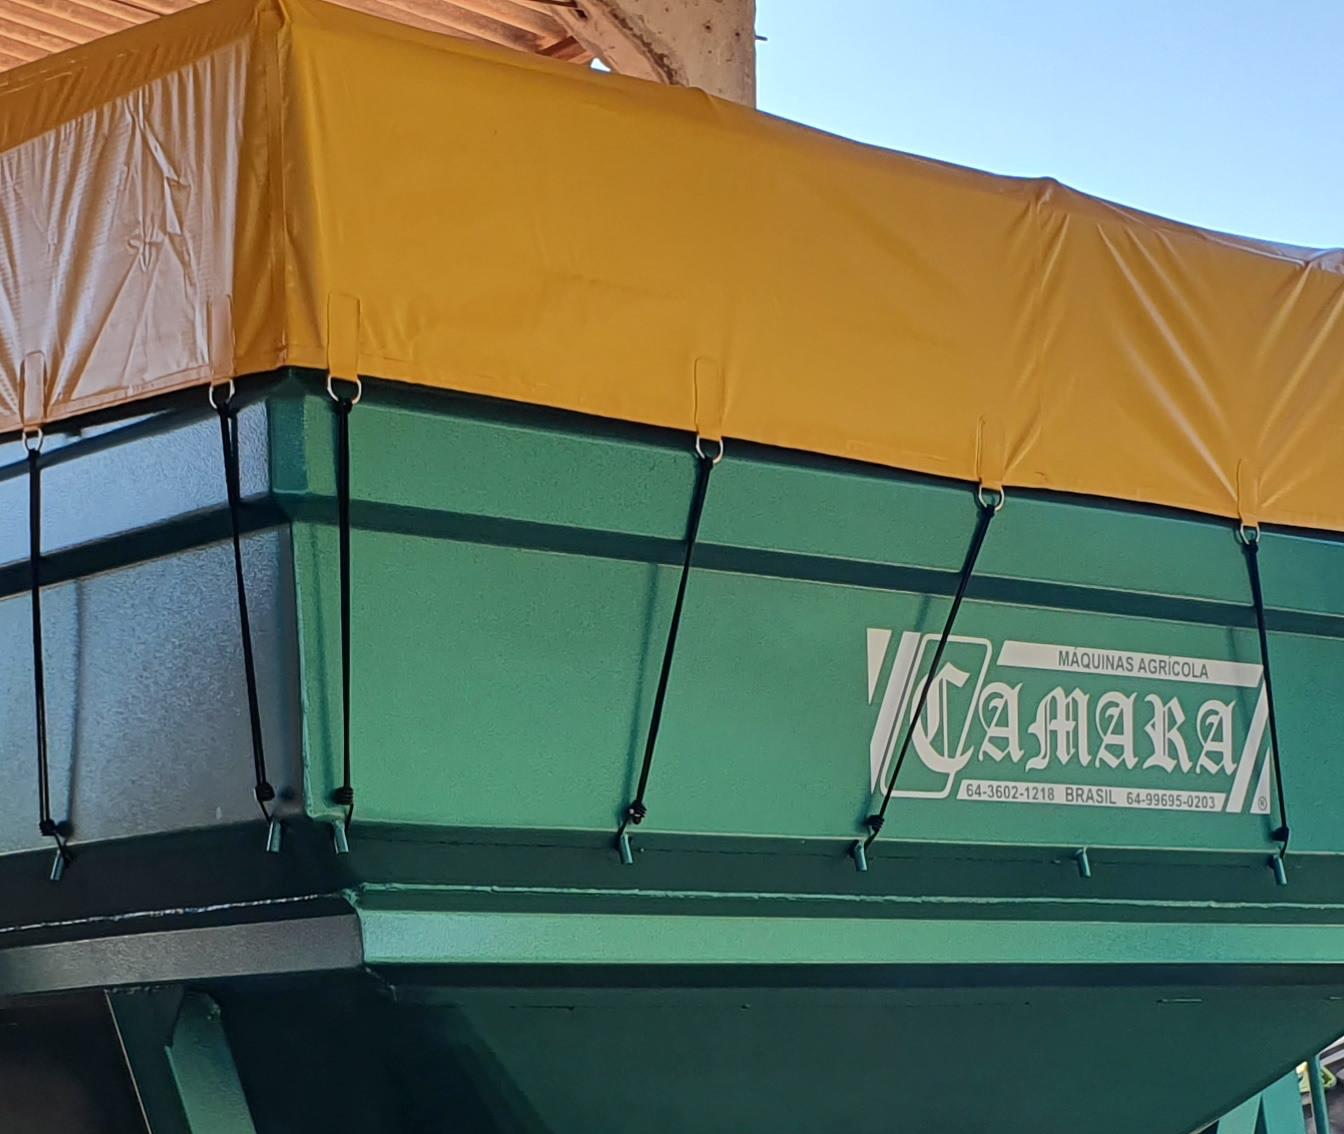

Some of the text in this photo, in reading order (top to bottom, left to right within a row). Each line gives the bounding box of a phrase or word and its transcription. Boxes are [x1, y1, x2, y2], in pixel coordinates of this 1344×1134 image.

[910, 661, 1238, 777] CAMARA
[966, 783, 1216, 809] 64-3602-1218 BRASIL 64-99695-0203
